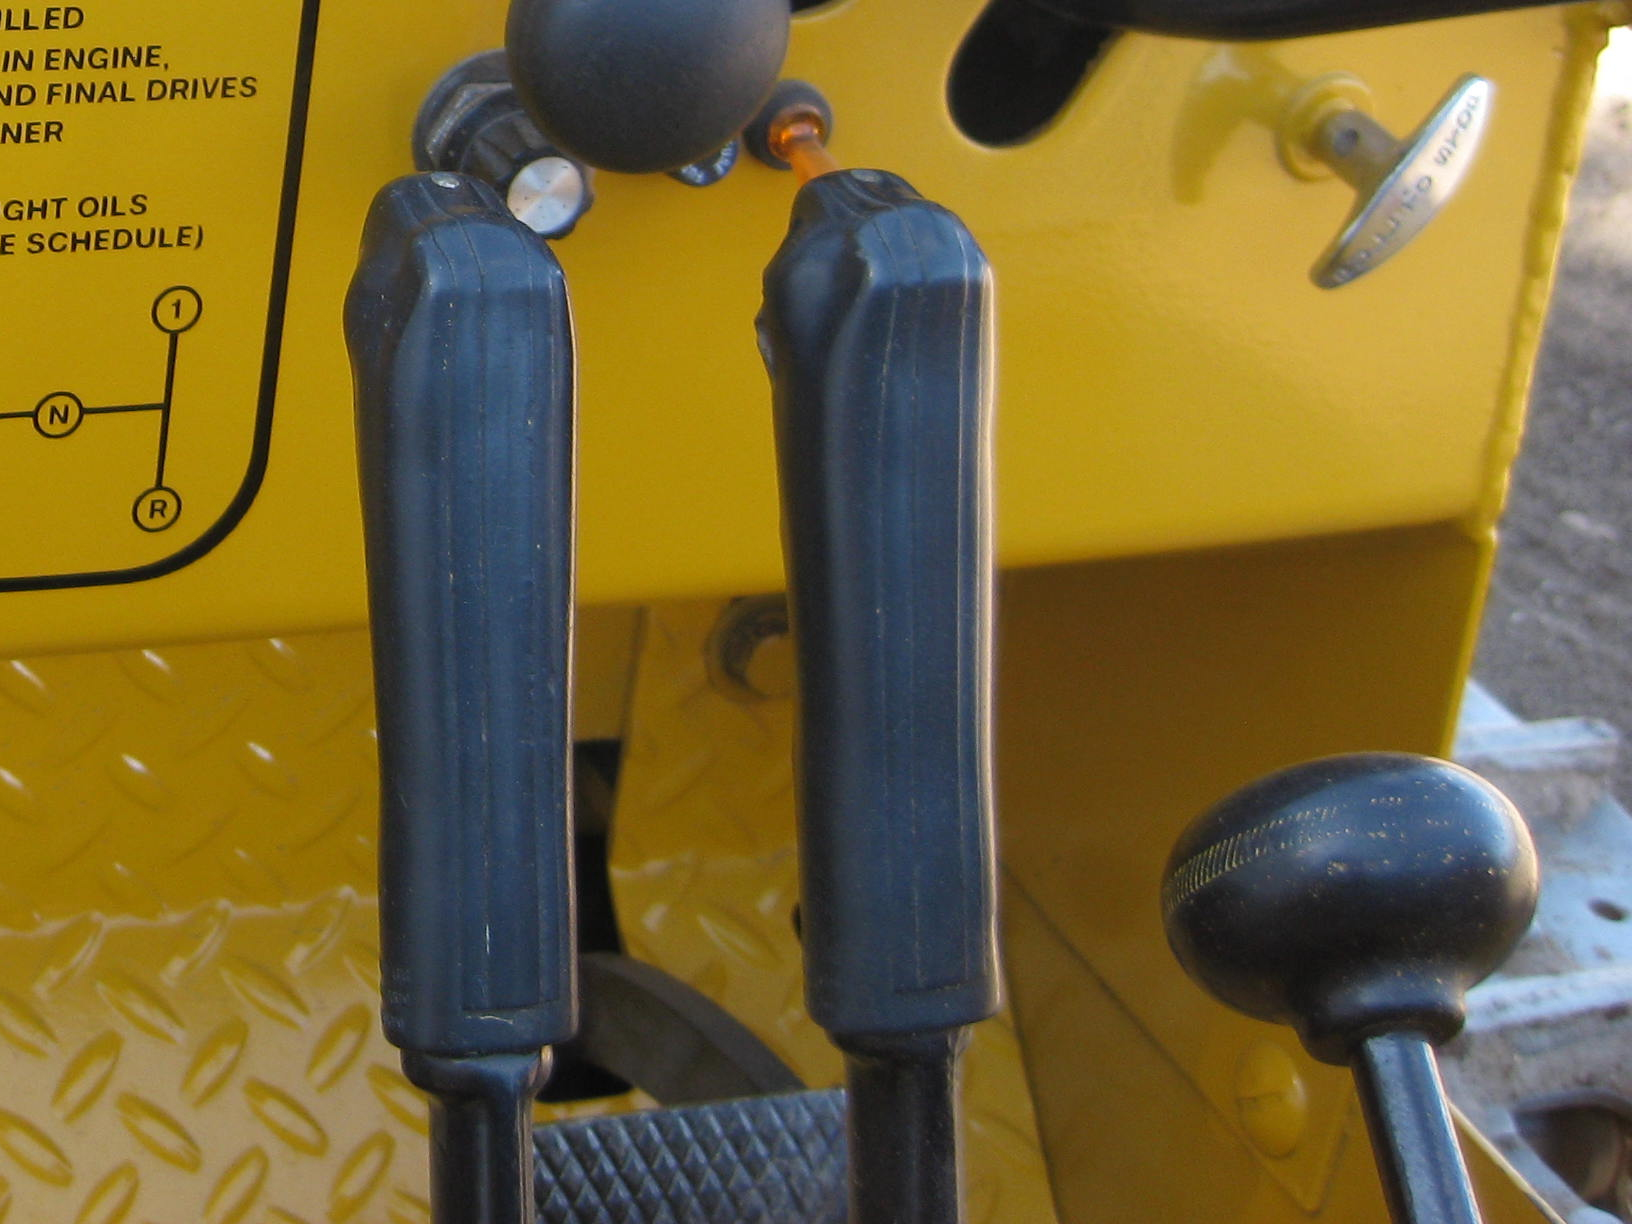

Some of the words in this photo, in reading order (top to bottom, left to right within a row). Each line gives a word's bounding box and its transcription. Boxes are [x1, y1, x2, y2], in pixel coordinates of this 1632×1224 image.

[1, 49, 34, 73] IN
[44, 45, 169, 71] ENGINE,
[46, 81, 136, 105] FINAL
[147, 76, 257, 102] DRIVES
[77, 194, 148, 218] OILS
[27, 225, 204, 255] SCHEDULE)
[171, 299, 181, 319] 1
[49, 404, 69, 425] N
[149, 499, 168, 520] R
